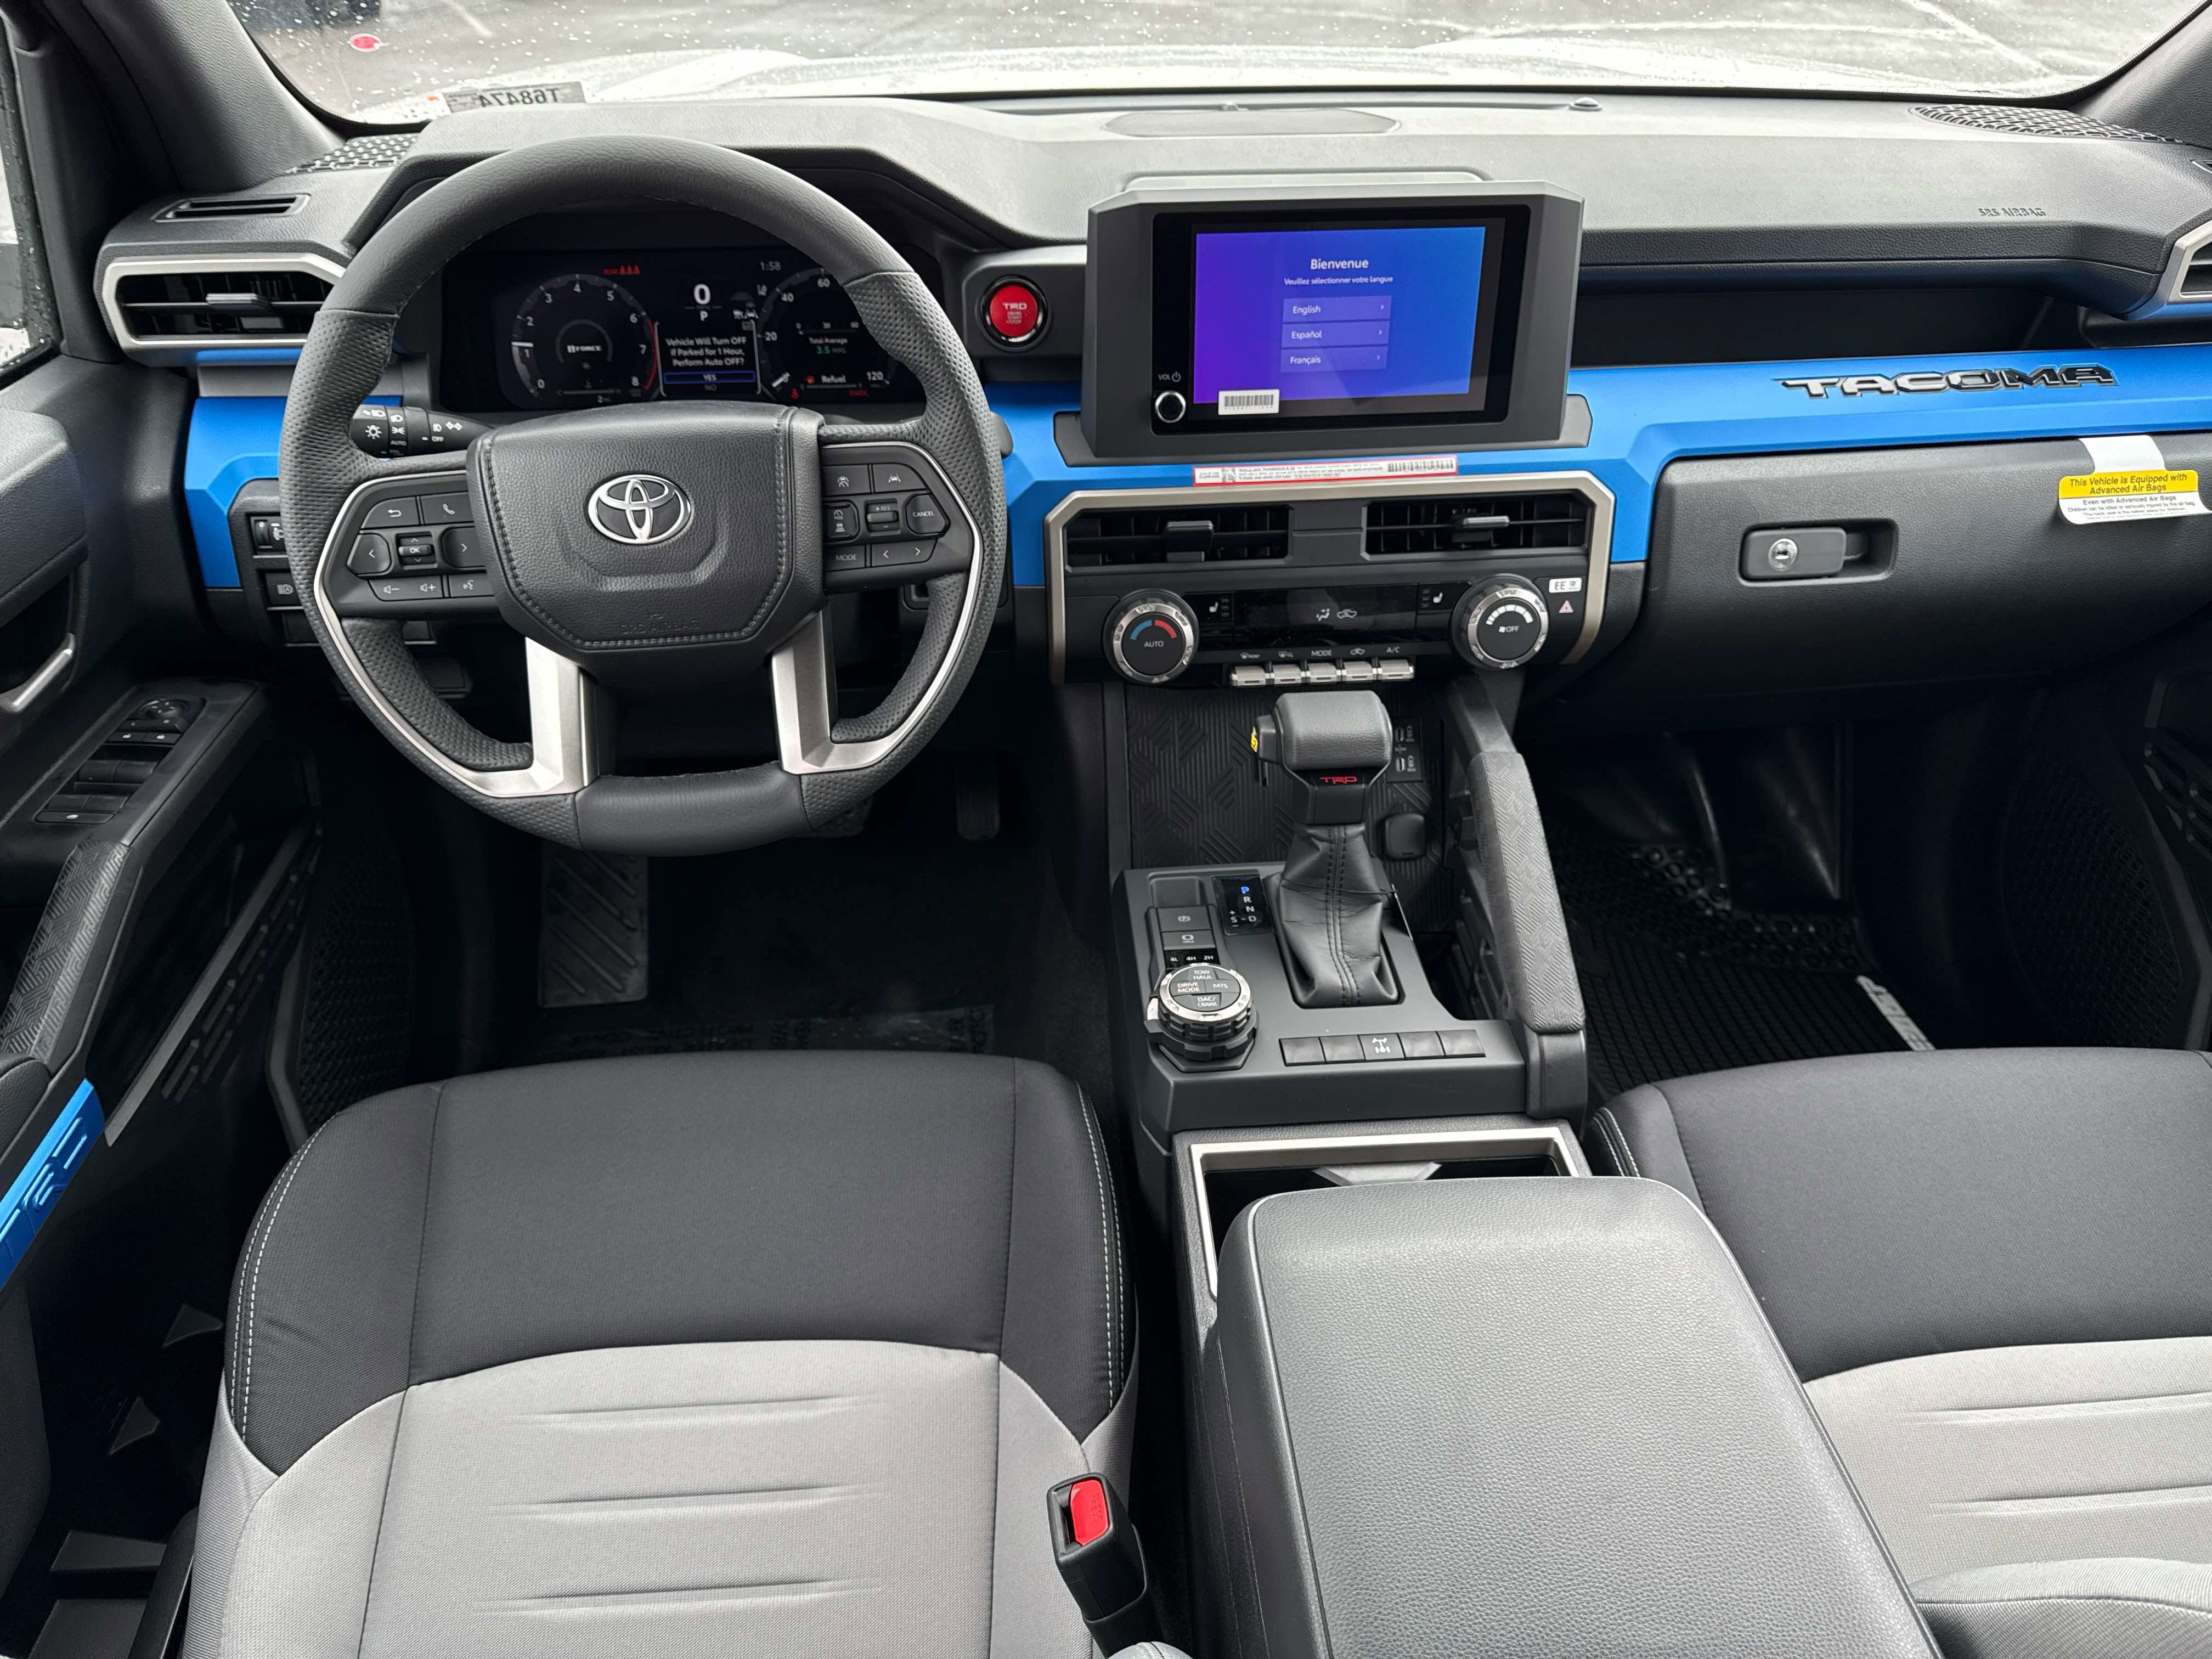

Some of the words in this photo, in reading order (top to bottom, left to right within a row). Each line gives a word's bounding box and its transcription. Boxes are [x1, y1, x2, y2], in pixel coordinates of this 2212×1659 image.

[2001, 208, 2046, 216] AIRBAG
[760, 261, 782, 272] 1:58
[1310, 258, 1369, 271] Bienvenue
[817, 278, 831, 288] 60
[1284, 276, 1310, 285] Veuillez
[1311, 275, 1351, 285] sélectionner
[1351, 275, 1369, 284] votre
[1369, 275, 1394, 285] langue
[573, 283, 582, 293] 4
[544, 294, 552, 303] 3
[607, 291, 614, 301] 5
[693, 283, 712, 305] 0
[781, 292, 794, 303] 40
[1292, 304, 1321, 316] English
[630, 313, 638, 323] 6
[699, 310, 708, 322] P
[526, 317, 534, 326] 2
[764, 331, 778, 342] 20
[1291, 330, 1323, 341] Español
[665, 337, 695, 346] Vehicle
[695, 336, 712, 345] Will
[712, 336, 730, 345] Turn
[730, 336, 747, 345] OFF
[524, 349, 530, 358] 1
[639, 345, 646, 356] 7
[677, 347, 704, 356] Parked
[704, 347, 716, 356] for
[672, 358, 703, 367] Perform
[704, 358, 724, 366] Auto
[724, 357, 745, 366] OFF?
[1289, 354, 1322, 366] Français
[631, 376, 639, 386] 8
[820, 374, 847, 383] Refuel
[866, 371, 884, 381] 120
[537, 379, 545, 388] 0
[1774, 364, 2120, 399] TACOMA
[2070, 478, 2087, 487] This
[2090, 476, 2118, 486] Vehicle
[2121, 476, 2128, 484] is
[2130, 474, 2168, 486] Equipped
[2090, 485, 2130, 495] Advanced
[2146, 484, 2166, 493] Bags
[1319, 775, 1358, 785] TRD
[1240, 886, 1250, 894] P
[1091, 1493, 1103, 1523] PRESS
